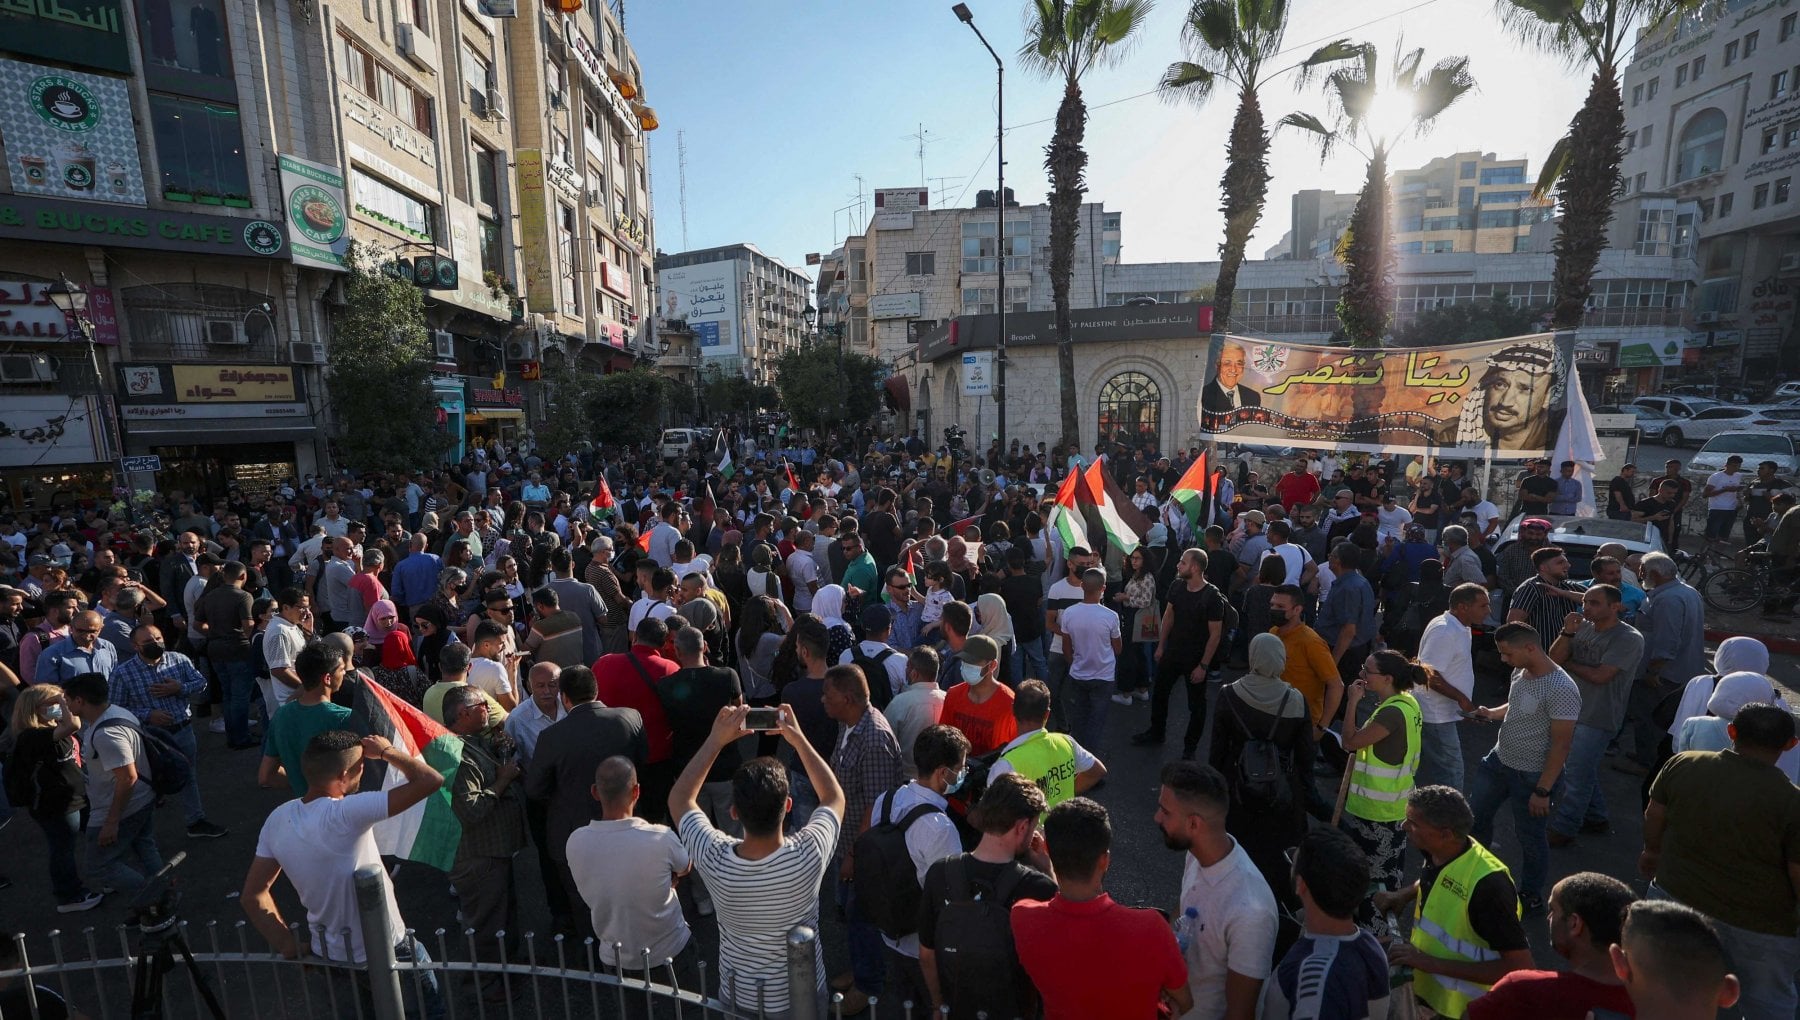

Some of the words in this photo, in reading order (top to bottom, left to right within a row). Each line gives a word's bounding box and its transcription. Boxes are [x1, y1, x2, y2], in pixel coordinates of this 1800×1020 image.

[1640, 54, 1666, 72] City
[1668, 30, 1714, 59] Center
[33, 79, 54, 102] STARS
[56, 79, 64, 87] &
[68, 82, 97, 111] BUCKS
[49, 117, 89, 131] CAFE
[281, 159, 300, 171] STARS
[306, 168, 326, 181] BUCKS
[327, 175, 342, 187] CAFE
[293, 189, 310, 210] STARS
[318, 191, 340, 218] BUCKS
[36, 208, 150, 238] BUCKS
[158, 219, 234, 245] CAFE
[305, 228, 334, 240] CAFE
[690, 291, 725, 305] بتعمل
[691, 304, 726, 318] فرق
[1080, 318, 1116, 329] PALESTINE
[1123, 316, 1167, 328] فلسطين
[1169, 314, 1192, 325] بنك
[1262, 352, 1384, 395] تنتصر
[1404, 351, 1470, 405] بيتا
[186, 385, 237, 399] حواء
